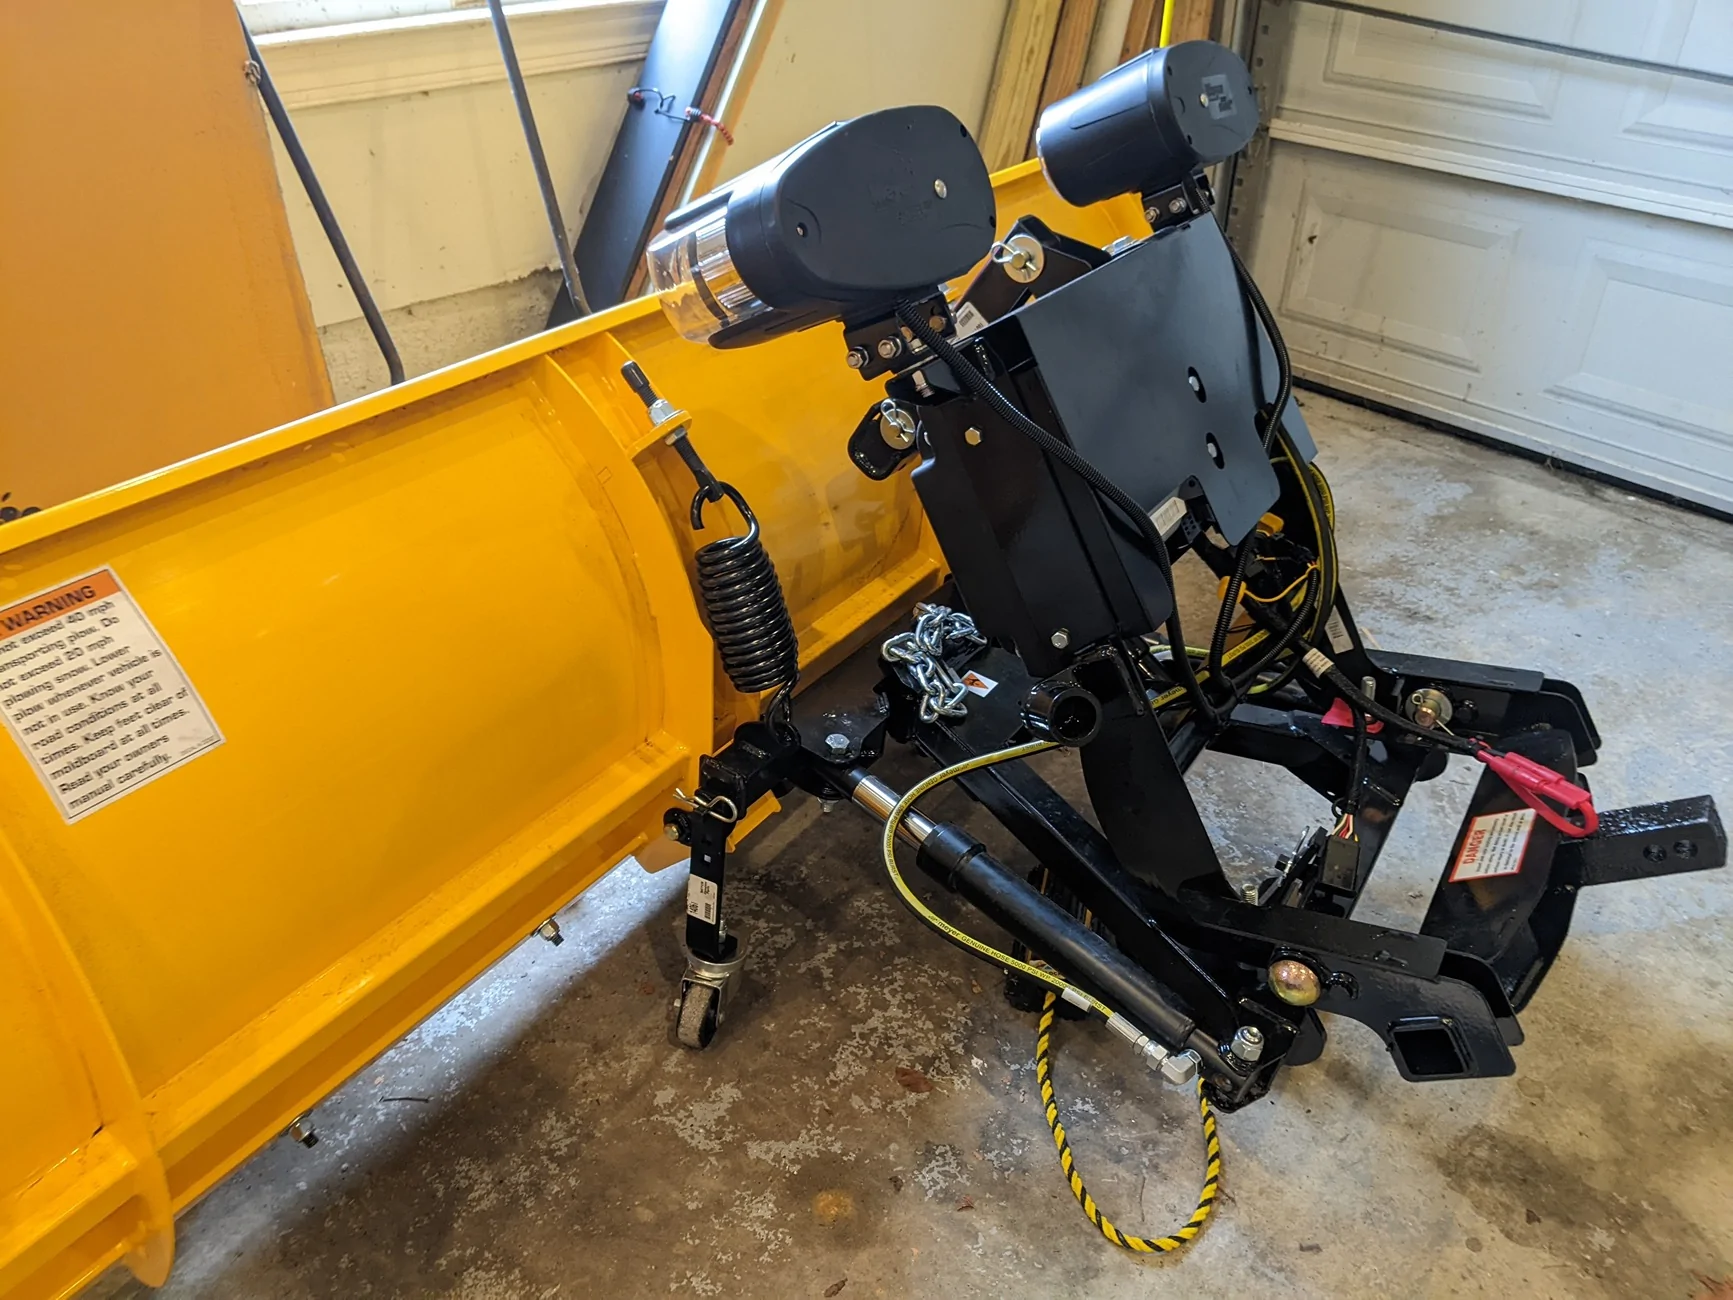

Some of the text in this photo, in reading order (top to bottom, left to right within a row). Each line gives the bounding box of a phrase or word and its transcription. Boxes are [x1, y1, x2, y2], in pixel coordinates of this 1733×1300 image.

[0, 600, 116, 655] not exceed 40 mph
[4, 585, 96, 631] WARNING
[66, 626, 100, 645] plow.
[100, 616, 120, 627] Do
[2, 645, 131, 709] plowing snow. Lower
[19, 655, 64, 681] exceed
[63, 647, 84, 661] 20
[86, 635, 115, 651] mph
[12, 649, 162, 724] plow whenever vehicle is
[22, 669, 155, 735] not in use. Know your
[31, 681, 163, 750] road conditions at all
[40, 687, 189, 765] times. Keep feet clear of
[49, 708, 190, 780] moldboard at all times.
[58, 771, 94, 794] Read
[93, 758, 123, 779] your
[123, 735, 170, 761] owners
[68, 753, 172, 809] manual carefully.
[904, 791, 916, 806] HOSE
[915, 777, 938, 794] GENUINE
[939, 767, 960, 780] meyer
[1463, 828, 1487, 865] DANGER
[937, 921, 961, 937] meyer
[961, 935, 992, 954] GENUINE
[990, 949, 1010, 963] HOSE
[1010, 959, 1027, 970] 5000
[1026, 966, 1039, 975] PSI
[1039, 970, 1051, 980] WP
[1083, 993, 1106, 1012] BURST
